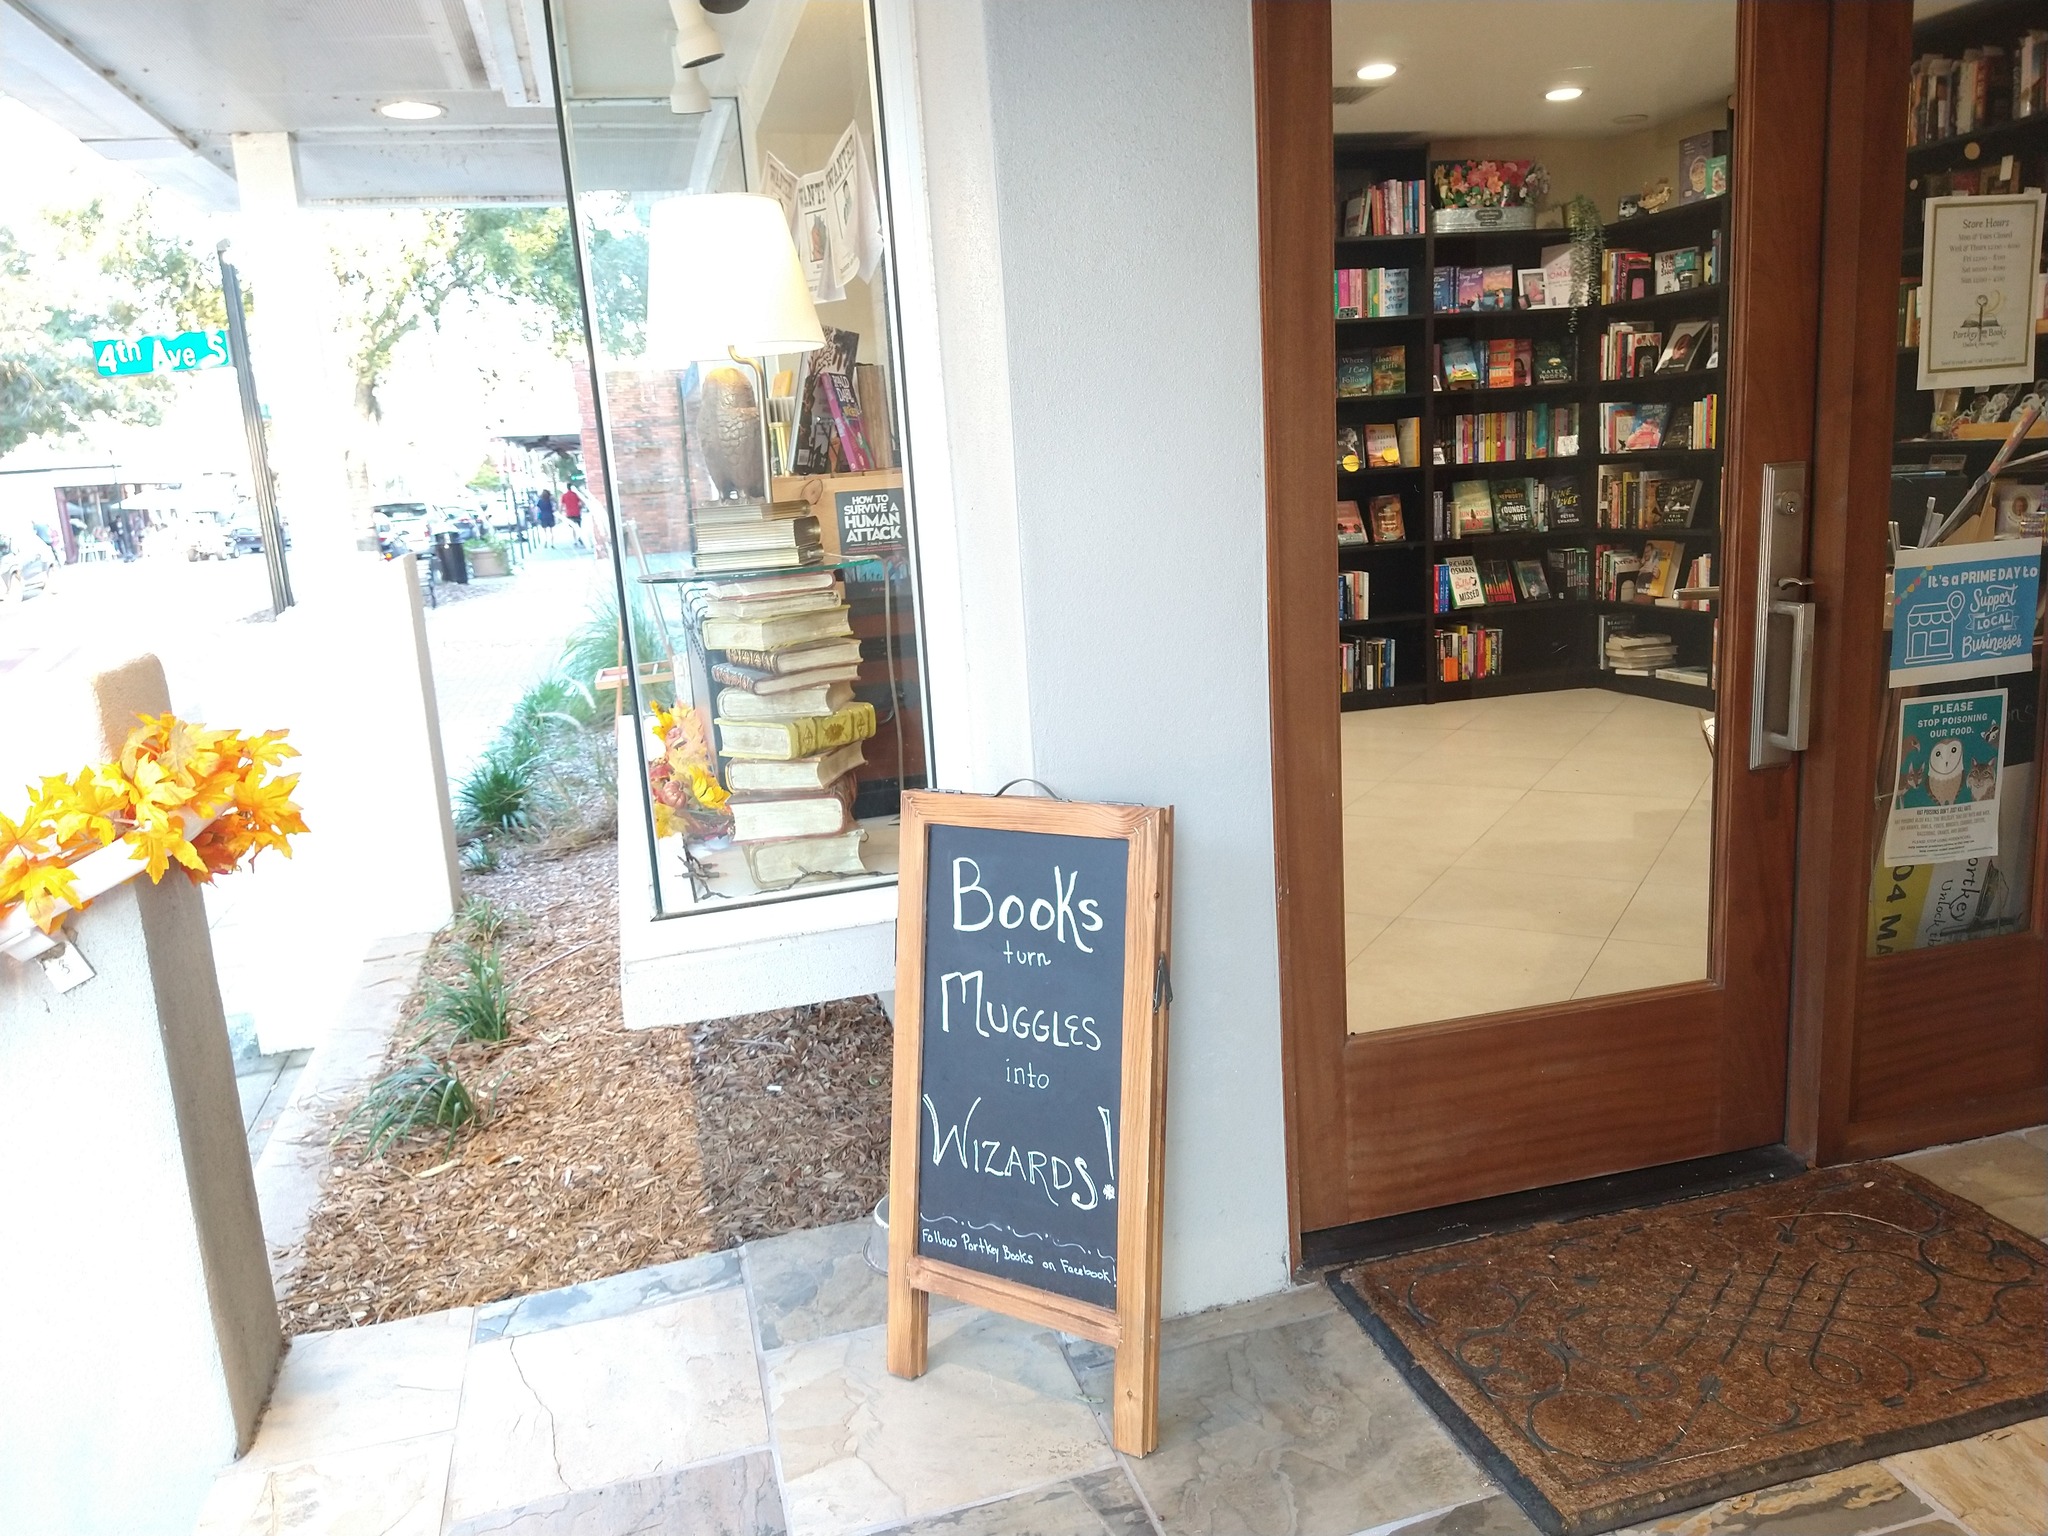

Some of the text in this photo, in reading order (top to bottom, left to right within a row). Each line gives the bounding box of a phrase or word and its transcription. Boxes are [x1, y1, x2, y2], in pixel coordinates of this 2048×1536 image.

[1962, 217, 2010, 229] Store Hours
[1993, 231, 2013, 239] Closed
[1952, 326, 2008, 342] Portkey Books
[98, 334, 227, 373] 4th Ave S
[851, 494, 889, 505] HOW TO
[843, 502, 899, 515] SURVIVE A
[844, 512, 901, 529] HUMAN
[846, 525, 902, 543] ATTACK
[1449, 559, 1473, 567] RICHARD
[1450, 566, 1475, 575] OSMAN
[1928, 566, 2038, 588] It's a PRIME DAY to
[1459, 588, 1480, 602] MISSED
[1969, 583, 2018, 613] Support
[1977, 612, 2012, 630] LOCAL
[1961, 633, 2023, 659] Businesses
[1932, 700, 1974, 716] PLEASE
[1917, 712, 1988, 728] STOP POISONING
[1929, 724, 1975, 739] OUR FOOD.
[1925, 879, 1954, 933] Unlock
[1003, 940, 1051, 966] turn
[1005, 1058, 1050, 1089] into
[922, 1094, 1116, 1210] WIZARDS!
[922, 1229, 957, 1248] Follow
[961, 1233, 1000, 1263] Portkey
[1003, 1245, 1034, 1265] Books
[1042, 1260, 1056, 1272] on
